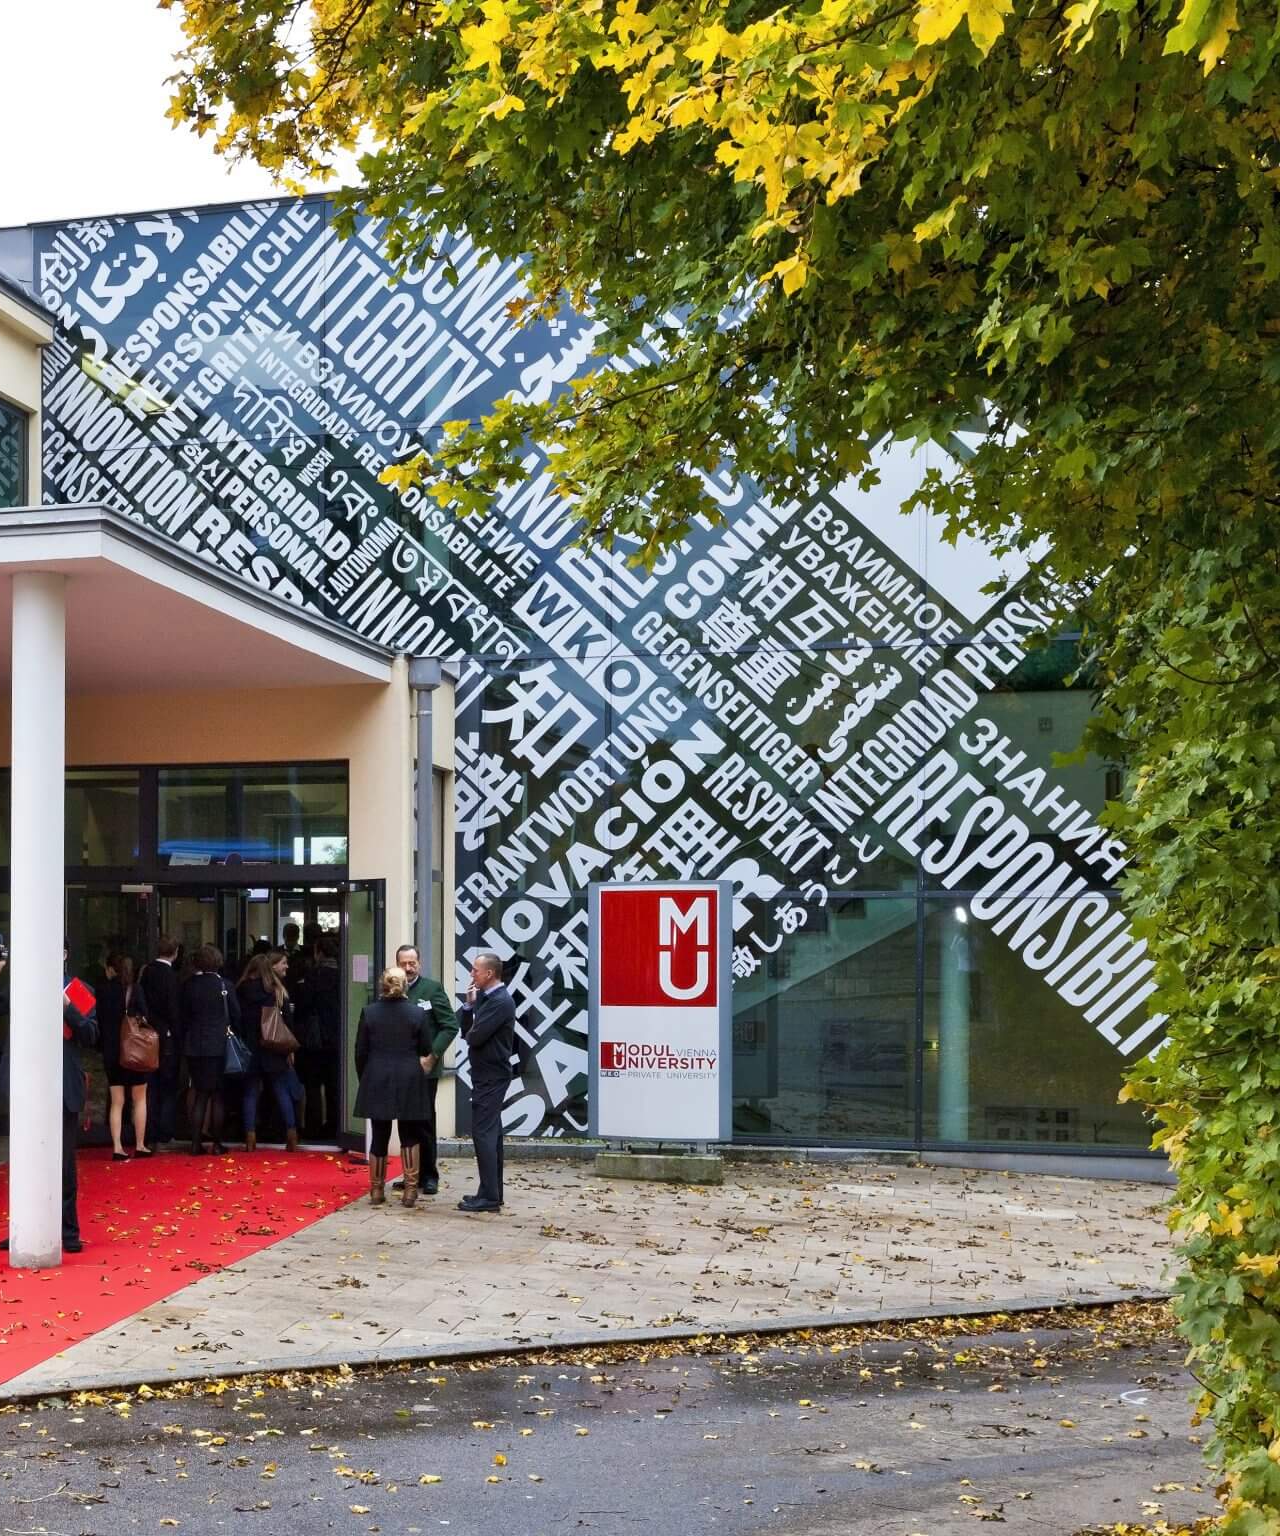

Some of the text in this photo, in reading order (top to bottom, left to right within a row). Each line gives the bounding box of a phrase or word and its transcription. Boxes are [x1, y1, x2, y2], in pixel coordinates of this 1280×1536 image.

[124, 200, 320, 421] PERSÖNLICHE
[150, 298, 282, 449] INTEGRITÄT
[272, 223, 493, 436] INTEGRITY
[44, 364, 206, 534] INNOVATION
[256, 349, 359, 449] INTEGRIDADE
[297, 447, 334, 486] WISSEN
[200, 412, 351, 560] INTEGRIDAD
[220, 476, 328, 588] PERSONAL
[332, 516, 404, 597] AUTONOMIA
[518, 576, 650, 708] WKO
[738, 554, 849, 662] 相互
[779, 524, 941, 676] УВАЖЕНИЕ
[803, 502, 962, 649] ВЗАИМНОЕ
[631, 611, 820, 795] GEGENSEITIGER
[697, 597, 802, 704] 尊重
[702, 752, 831, 873] RESPEKT
[808, 668, 978, 834] INTEGRIDAD
[960, 718, 1130, 881] ЗНАНИЯ
[872, 749, 1170, 1060] RESPONSIBILI
[676, 1049, 717, 1057] VIENNA
